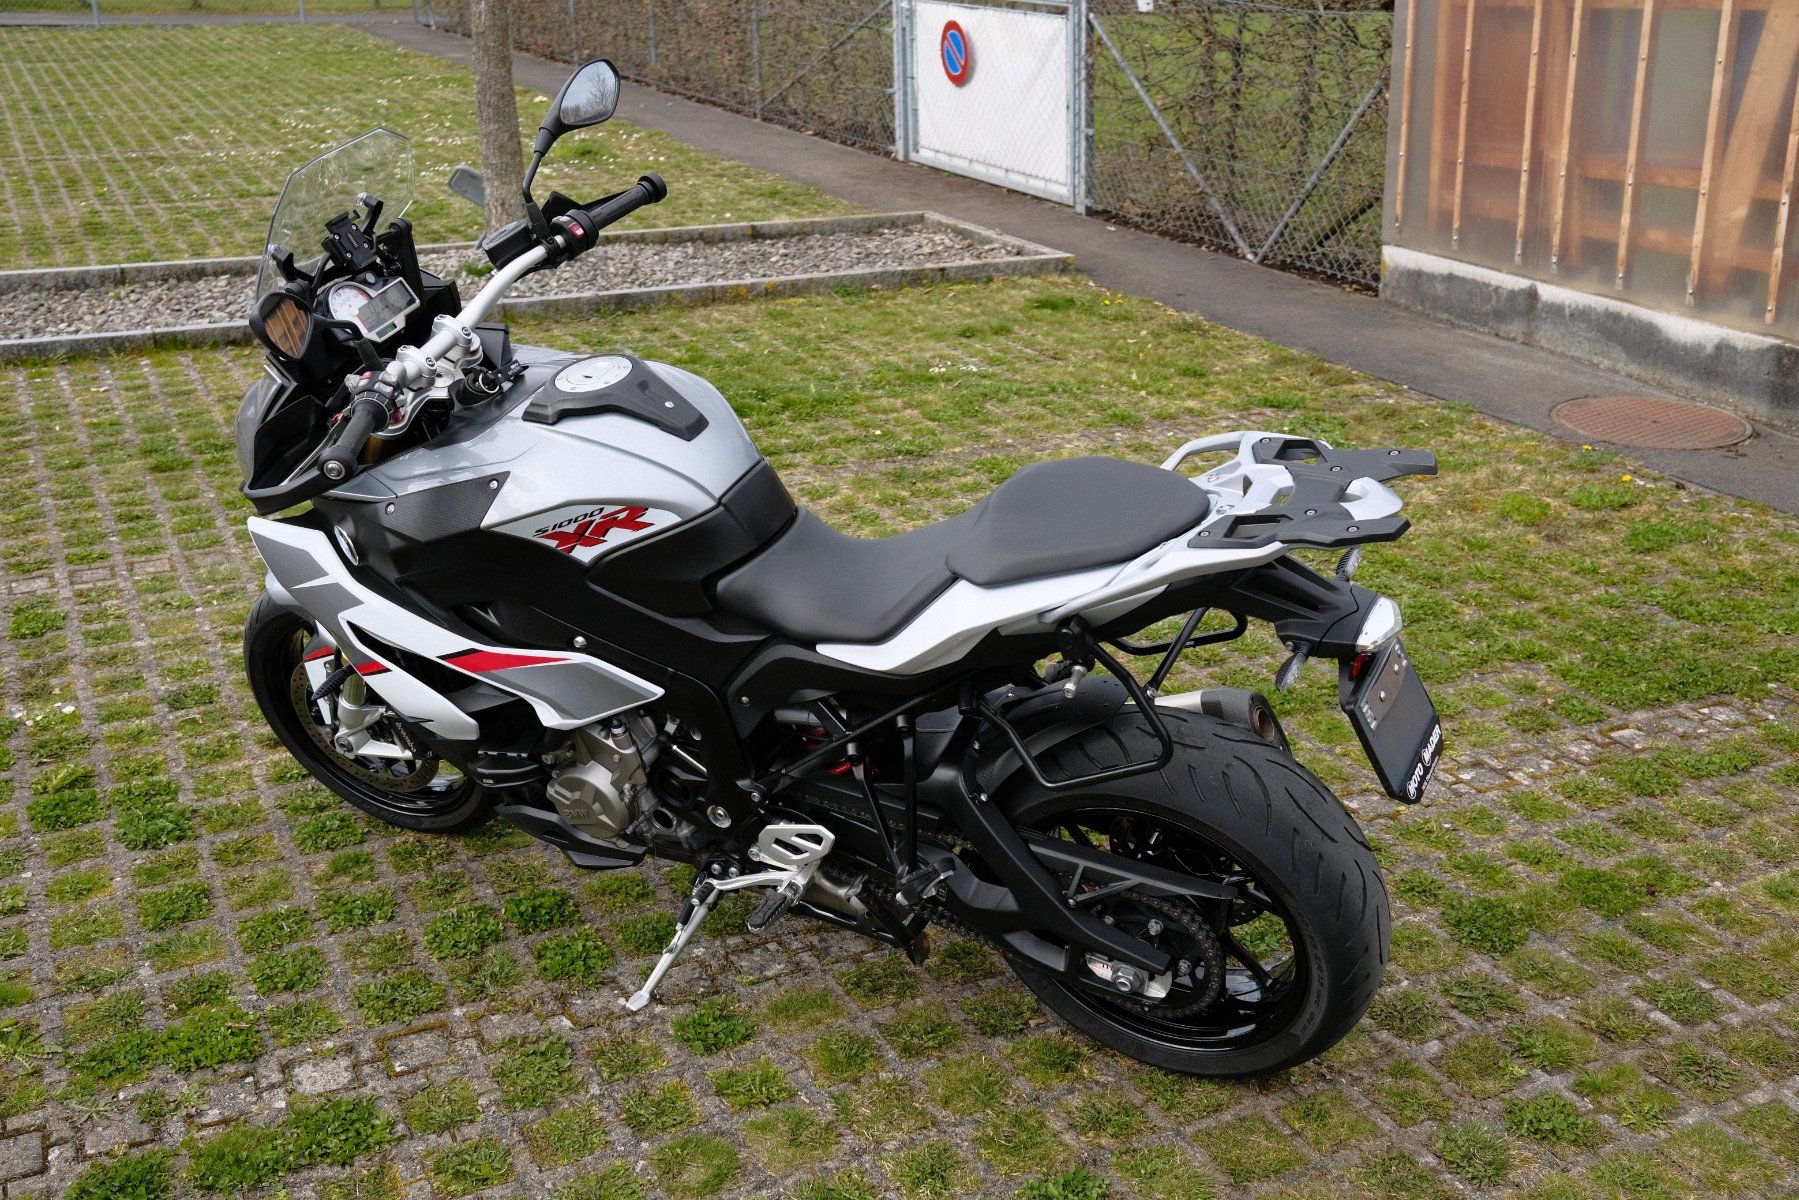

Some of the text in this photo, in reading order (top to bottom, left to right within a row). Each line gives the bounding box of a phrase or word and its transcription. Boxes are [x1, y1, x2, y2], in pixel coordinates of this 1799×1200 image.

[532, 506, 605, 537] S1000
[536, 504, 656, 553] XR
[1406, 762, 1424, 800] MOTO
[1421, 724, 1442, 767] MADER
